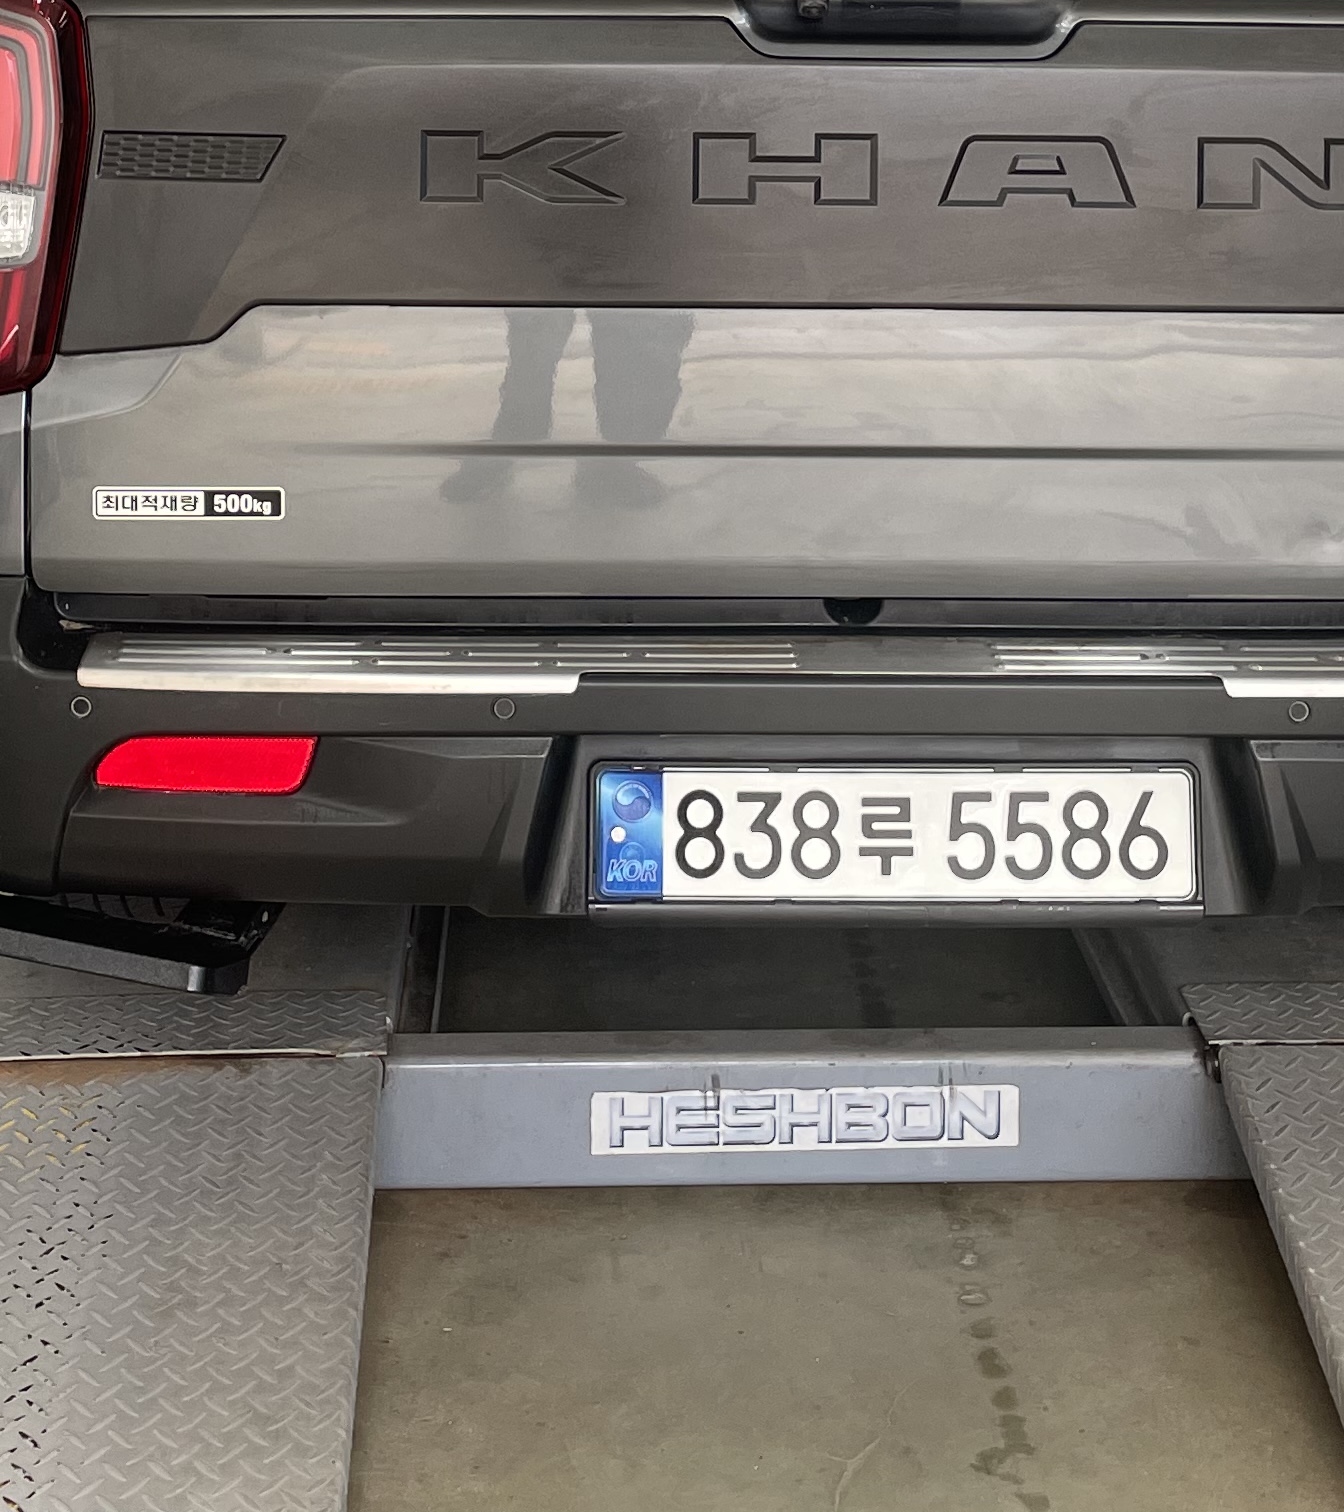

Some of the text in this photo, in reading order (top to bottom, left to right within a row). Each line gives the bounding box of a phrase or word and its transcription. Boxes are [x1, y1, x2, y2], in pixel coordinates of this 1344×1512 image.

[102, 494, 272, 515] 최대적재량 500kg
[946, 789, 1169, 881] 5586
[606, 859, 657, 882] KOR
[608, 1089, 1002, 1148] HESHBON
